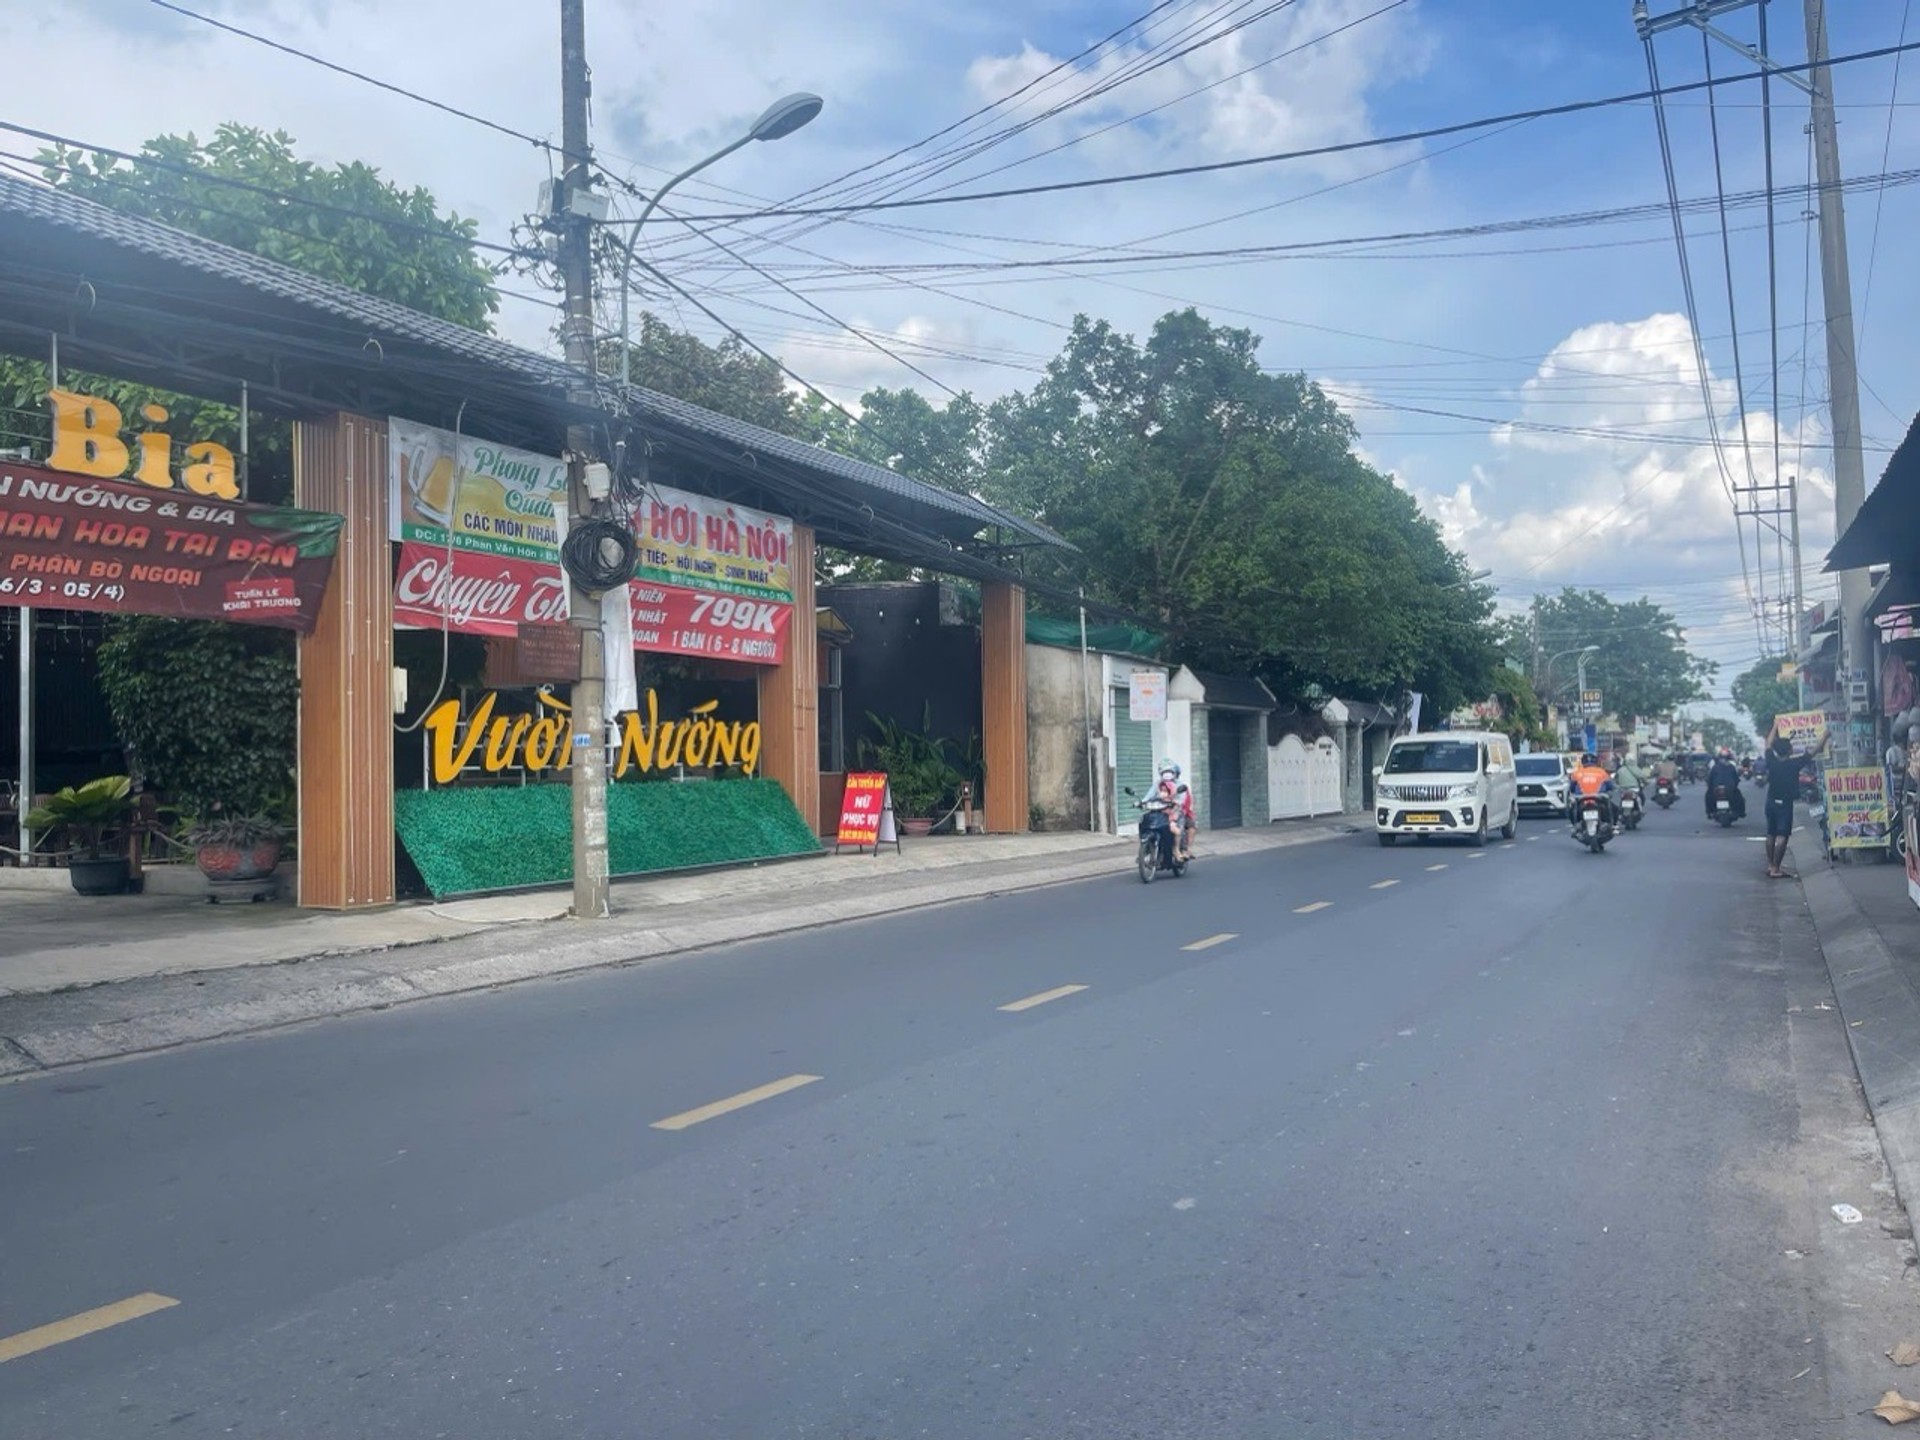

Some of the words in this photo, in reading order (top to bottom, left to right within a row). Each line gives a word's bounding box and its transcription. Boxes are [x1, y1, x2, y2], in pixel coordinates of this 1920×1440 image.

[46, 388, 241, 500] Bia
[19, 476, 151, 512] NƯỚNG
[157, 501, 180, 518] &
[187, 506, 236, 525] BIA
[0, 511, 63, 540] AN
[73, 519, 151, 549] HOA
[463, 511, 490, 533] CÁC
[651, 501, 698, 547] HƠI
[706, 506, 740, 556] HÀ
[746, 518, 788, 573] NỘI
[10, 552, 82, 576] PHẦN
[89, 557, 124, 579] BÒ
[63, 581, 126, 602] 05/4)
[399, 558, 521, 625] Chuyên
[637, 588, 666, 604] NIÊN
[690, 594, 779, 635] 799K
[615, 688, 761, 779] Nướng
[1848, 811, 1869, 823] 25K
